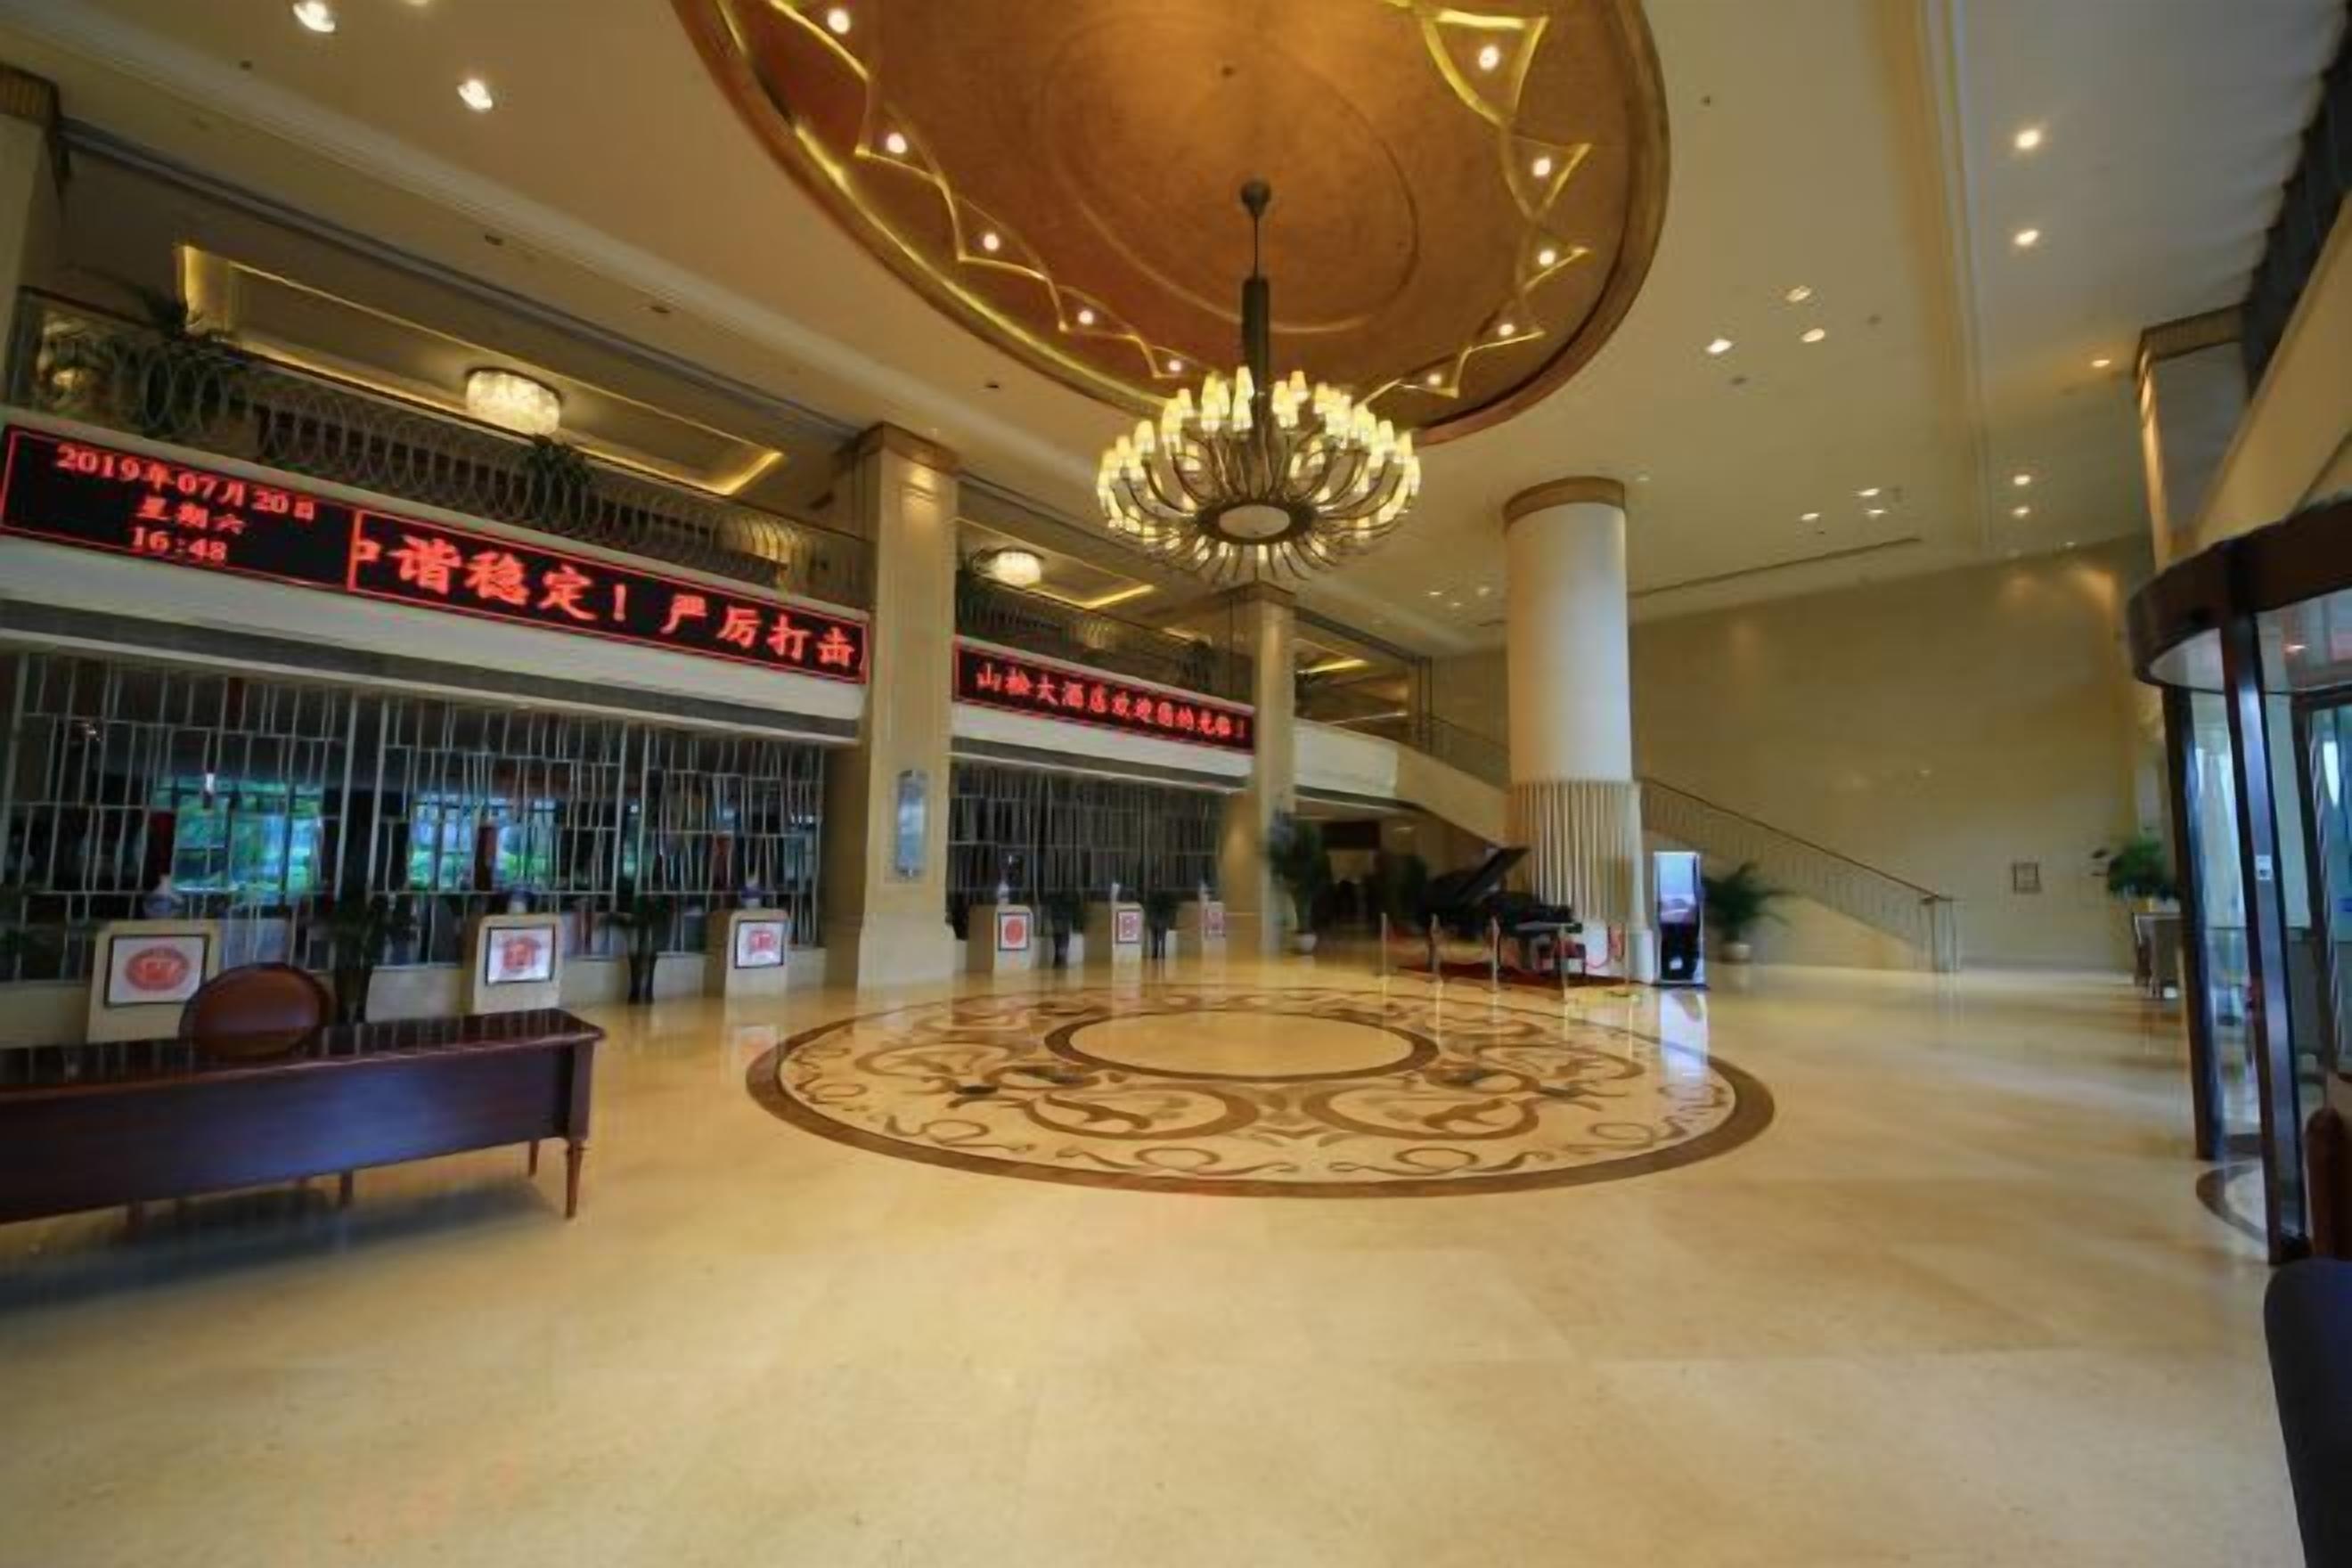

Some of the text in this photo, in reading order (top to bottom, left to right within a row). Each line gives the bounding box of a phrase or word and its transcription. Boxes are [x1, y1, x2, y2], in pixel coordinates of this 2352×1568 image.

[56, 444, 315, 521] 2019年07月20日
[134, 495, 248, 535] 星期六
[133, 527, 227, 560] 16:48
